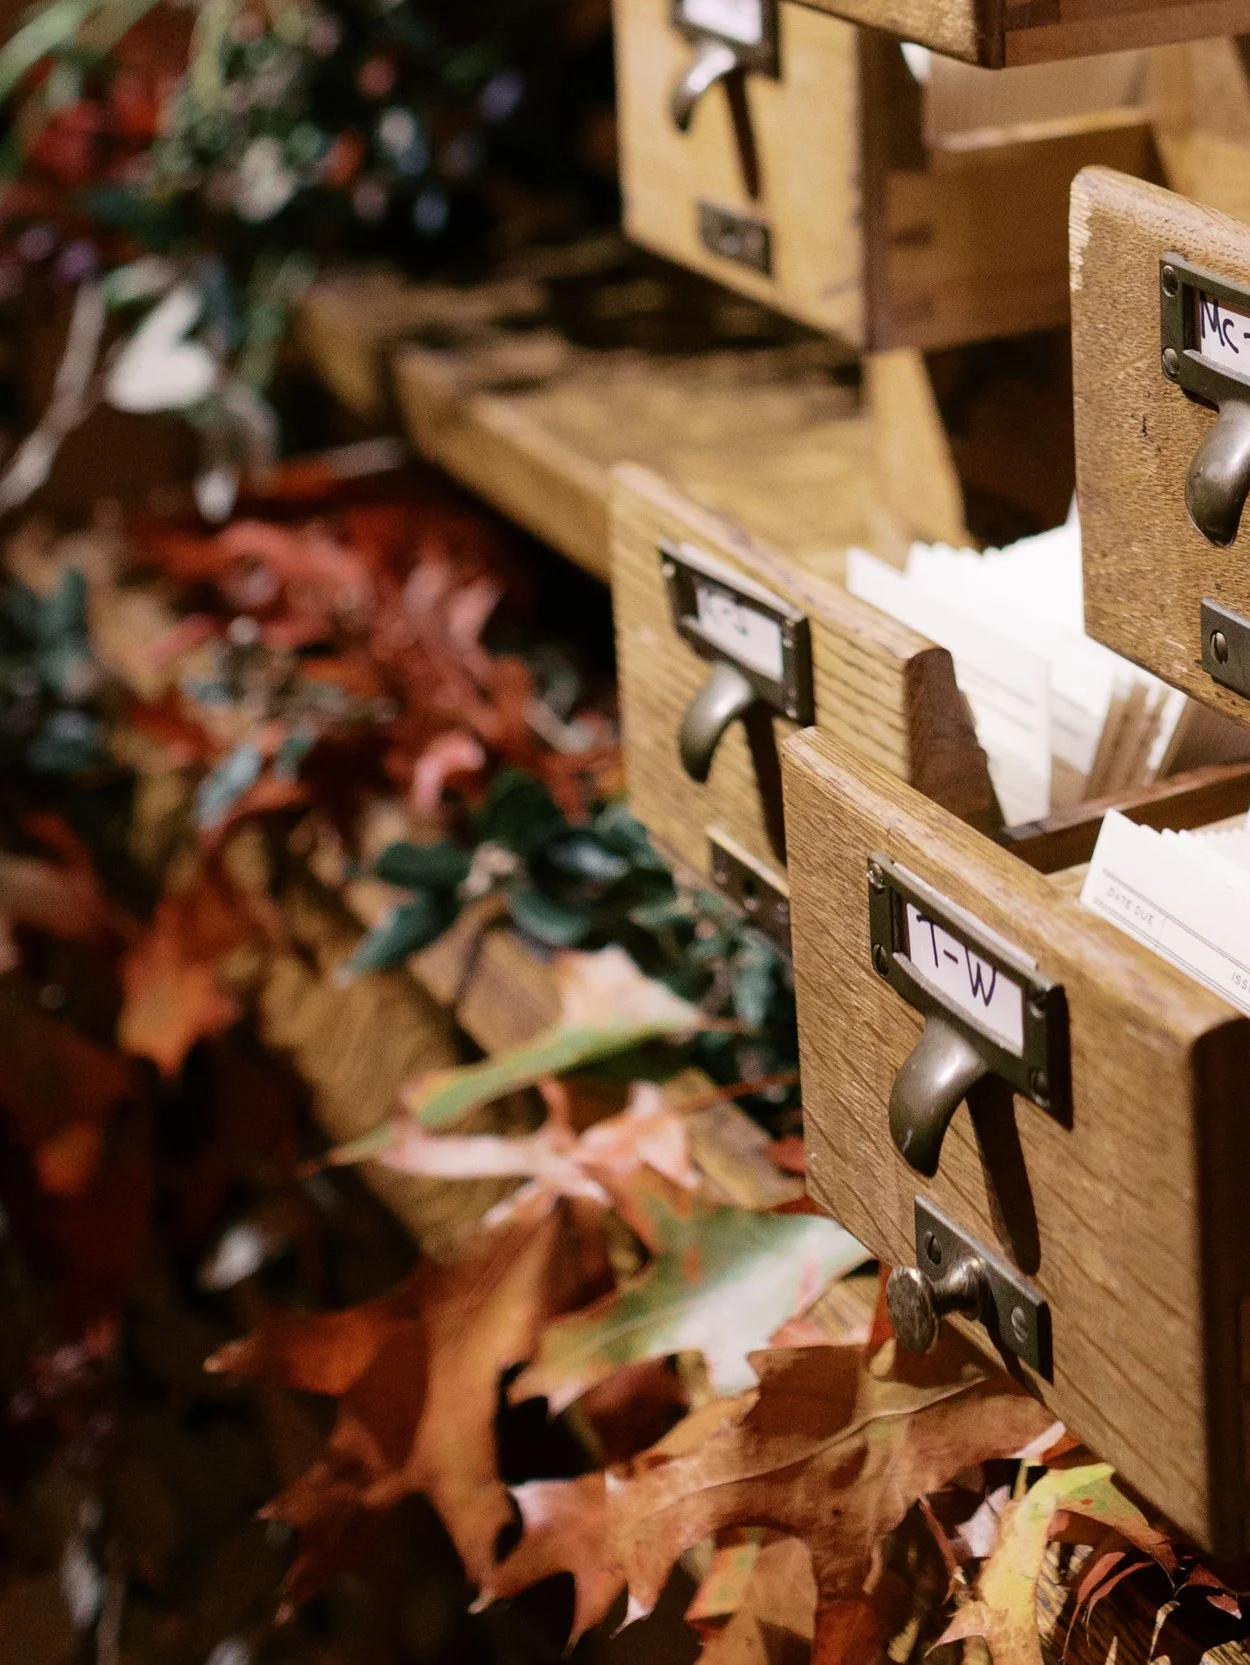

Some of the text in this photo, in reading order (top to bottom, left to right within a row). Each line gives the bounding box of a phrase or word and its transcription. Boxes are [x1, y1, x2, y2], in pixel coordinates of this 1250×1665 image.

[1106, 886, 1156, 926] DATE DUE
[915, 914, 997, 1008] T-W
